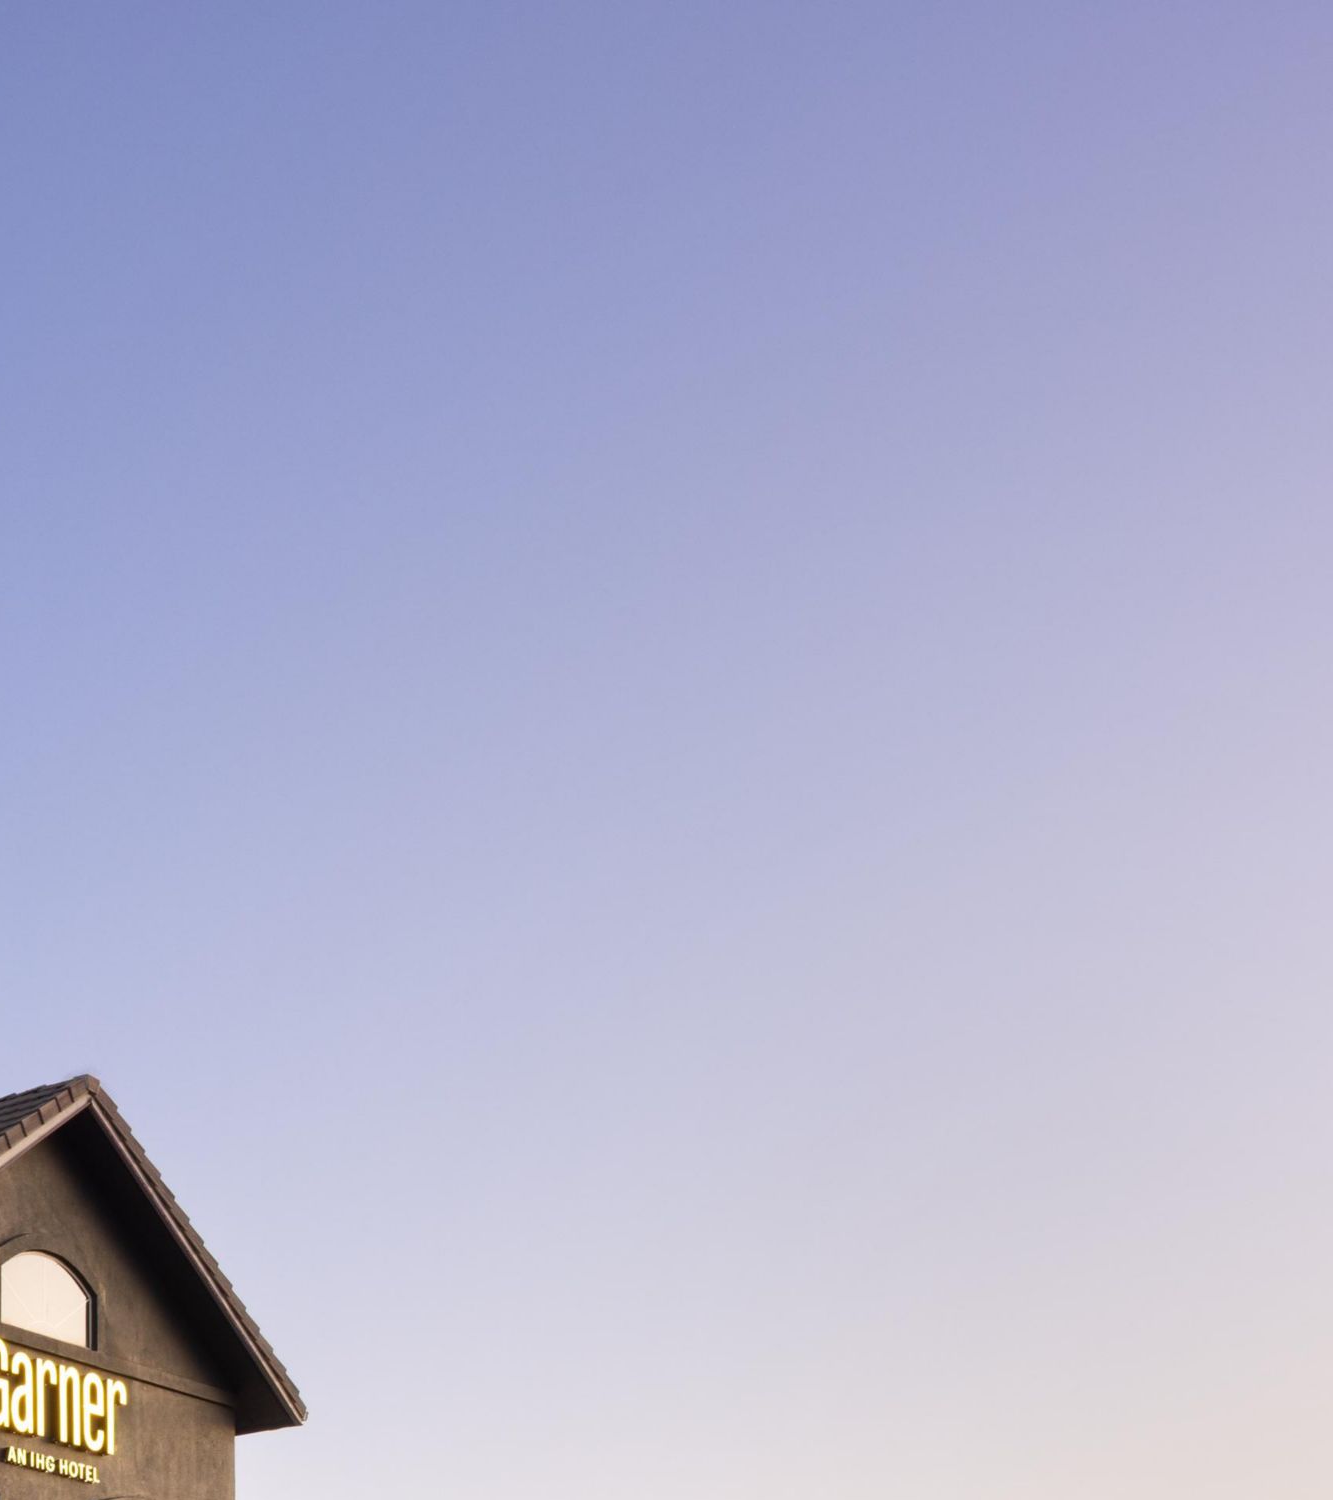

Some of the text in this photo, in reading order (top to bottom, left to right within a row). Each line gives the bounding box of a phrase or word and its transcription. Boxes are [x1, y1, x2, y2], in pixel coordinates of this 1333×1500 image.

[7, 1446, 100, 1484] AN IHG HOTEL
